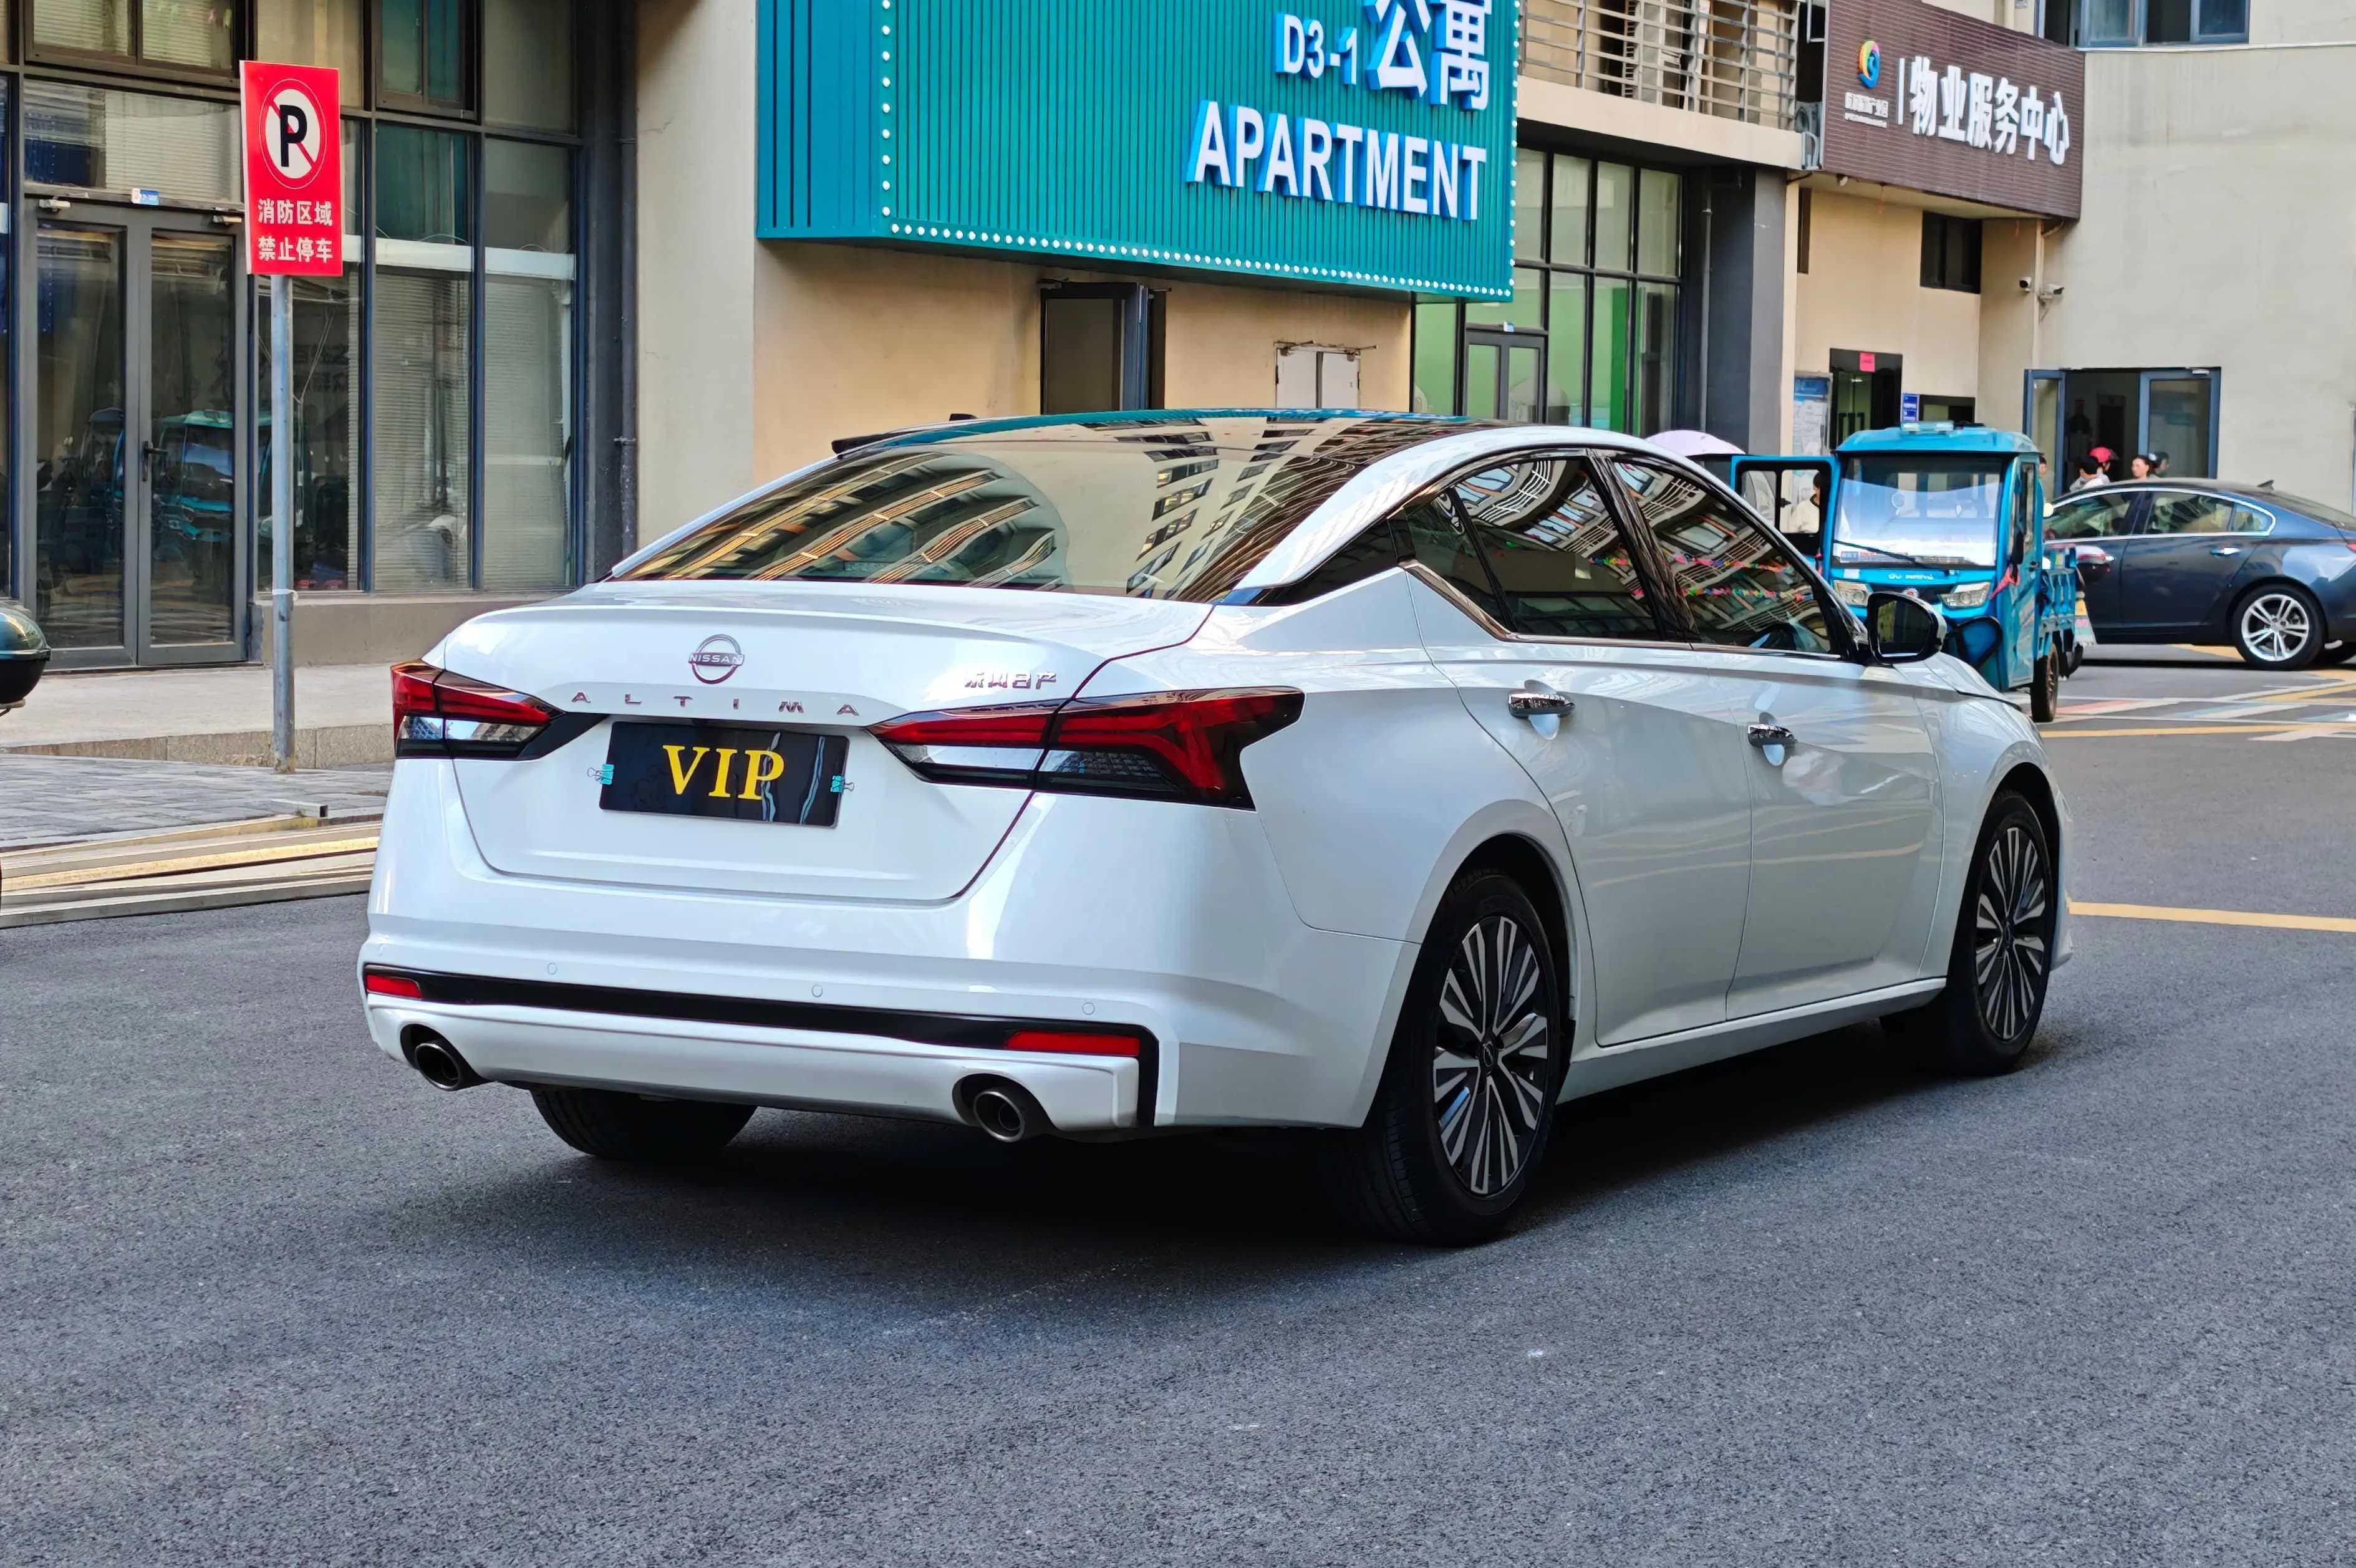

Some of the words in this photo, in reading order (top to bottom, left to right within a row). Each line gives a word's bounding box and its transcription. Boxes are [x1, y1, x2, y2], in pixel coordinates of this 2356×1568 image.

[1275, 12, 1358, 85] D3-1
[279, 104, 307, 168] P
[1909, 55, 2070, 165] 物业服务中心
[1186, 100, 1487, 221] APARTMENT
[257, 198, 333, 227] 消防区域
[258, 235, 333, 264] 禁止停车
[690, 653, 743, 664] NISSAN
[571, 691, 859, 716] ALTIMA
[662, 744, 785, 801] VIP
